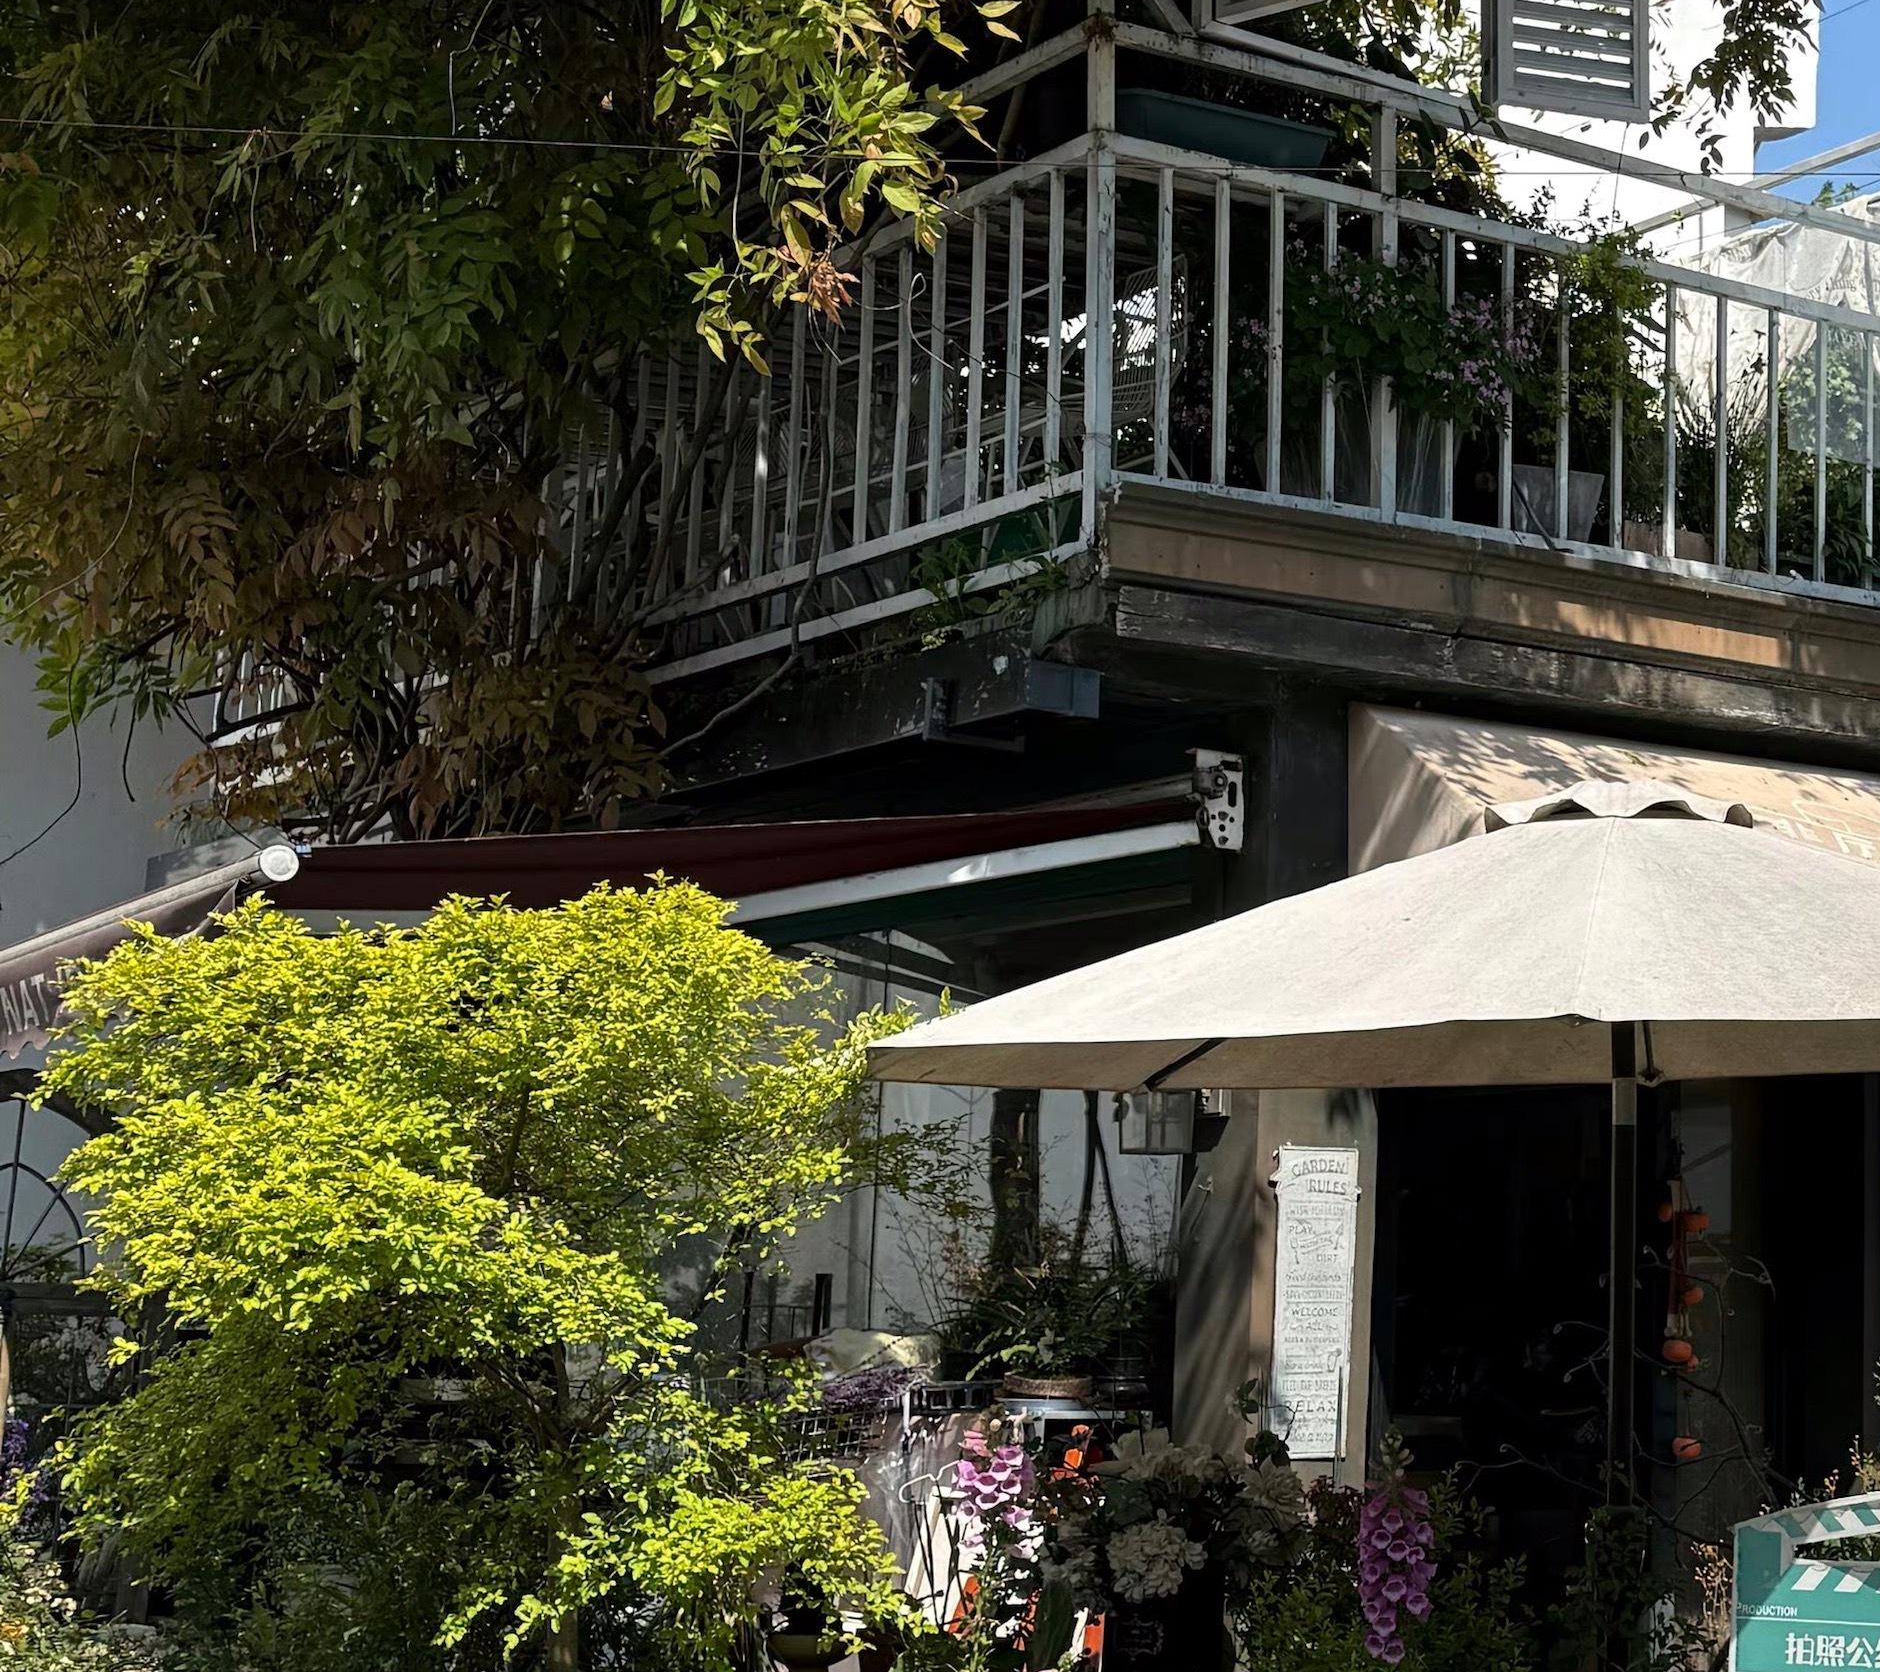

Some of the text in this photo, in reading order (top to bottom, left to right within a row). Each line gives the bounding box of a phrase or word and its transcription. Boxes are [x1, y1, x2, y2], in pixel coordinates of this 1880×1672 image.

[1291, 1157, 1349, 1177] GARDEN
[1305, 1178, 1351, 1196] RULES
[1291, 1306, 1339, 1317] WELCOME
[1736, 1602, 1798, 1617] PRODUCTION
